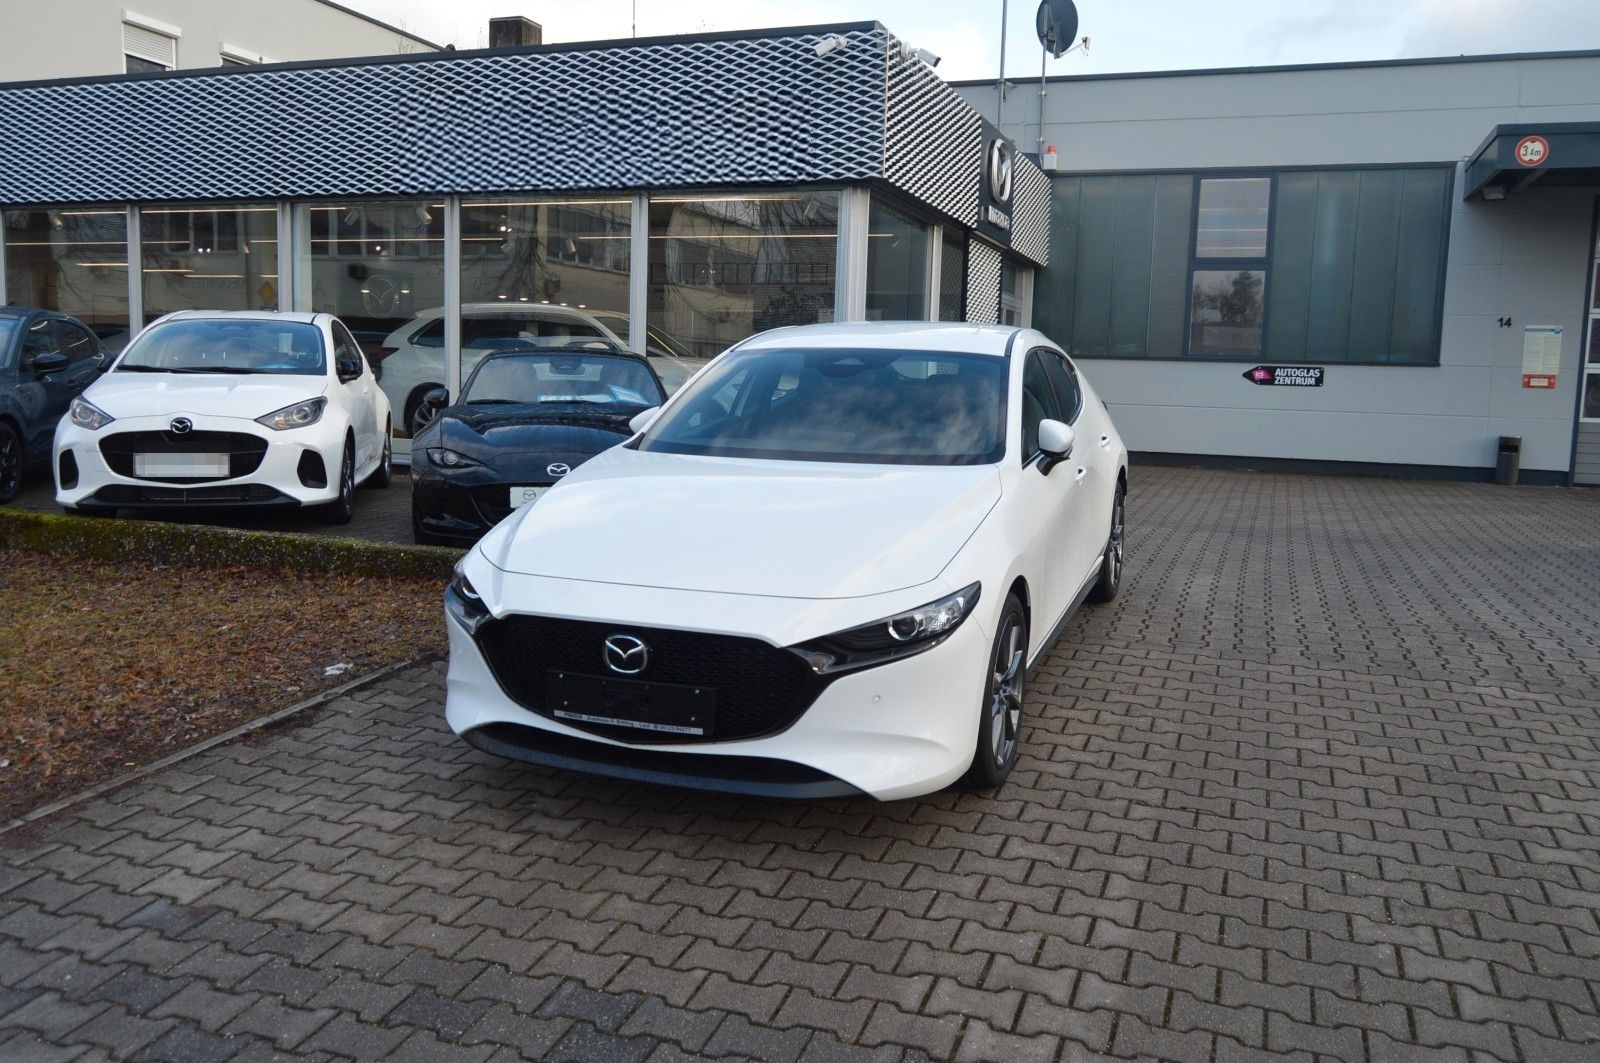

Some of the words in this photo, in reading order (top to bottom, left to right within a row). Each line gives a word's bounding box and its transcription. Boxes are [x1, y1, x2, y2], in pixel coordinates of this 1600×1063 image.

[1498, 316, 1512, 328] 14
[1274, 368, 1320, 377] AUTOGLAS
[1274, 377, 1315, 385] ZENTRUM
